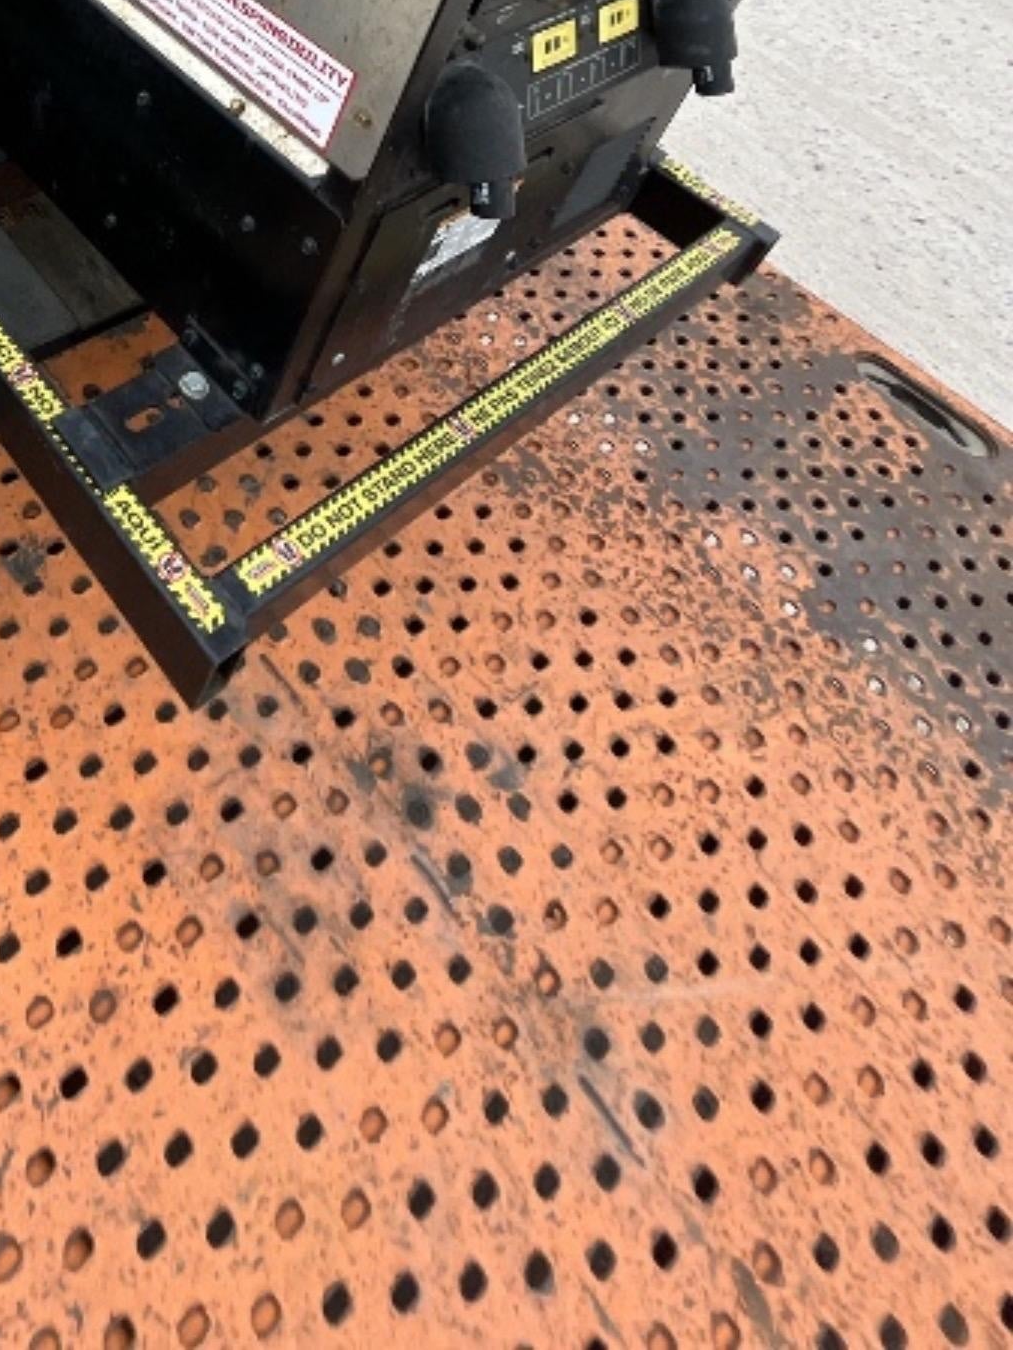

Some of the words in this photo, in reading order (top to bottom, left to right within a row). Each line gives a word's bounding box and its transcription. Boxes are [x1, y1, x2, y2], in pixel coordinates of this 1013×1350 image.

[295, 522, 328, 549] DO
[324, 496, 364, 529] NOT
[360, 460, 417, 502] STAND
